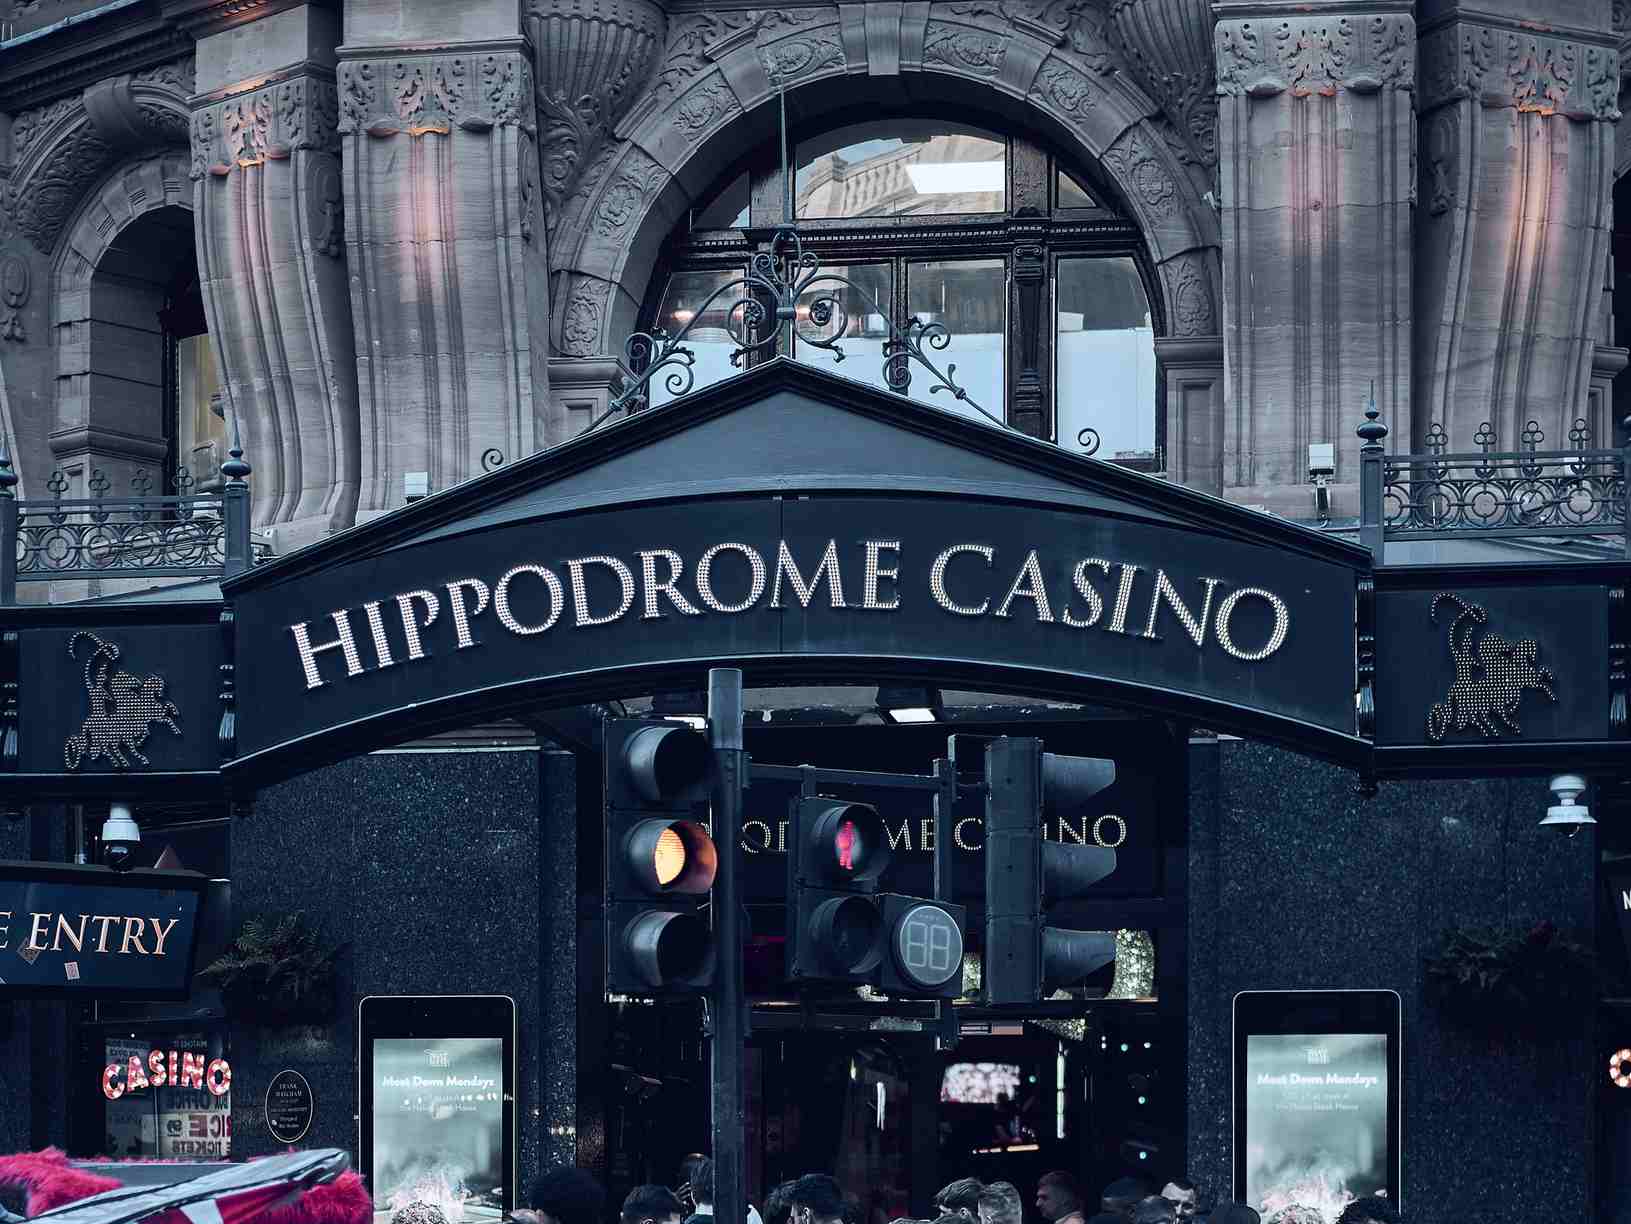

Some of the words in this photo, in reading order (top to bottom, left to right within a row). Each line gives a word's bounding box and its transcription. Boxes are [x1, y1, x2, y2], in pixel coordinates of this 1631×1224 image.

[288, 538, 901, 689] HIPPODROME
[929, 543, 1290, 661] CASINO
[25, 911, 180, 956] ENTRY
[102, 1049, 232, 1100] CASINO
